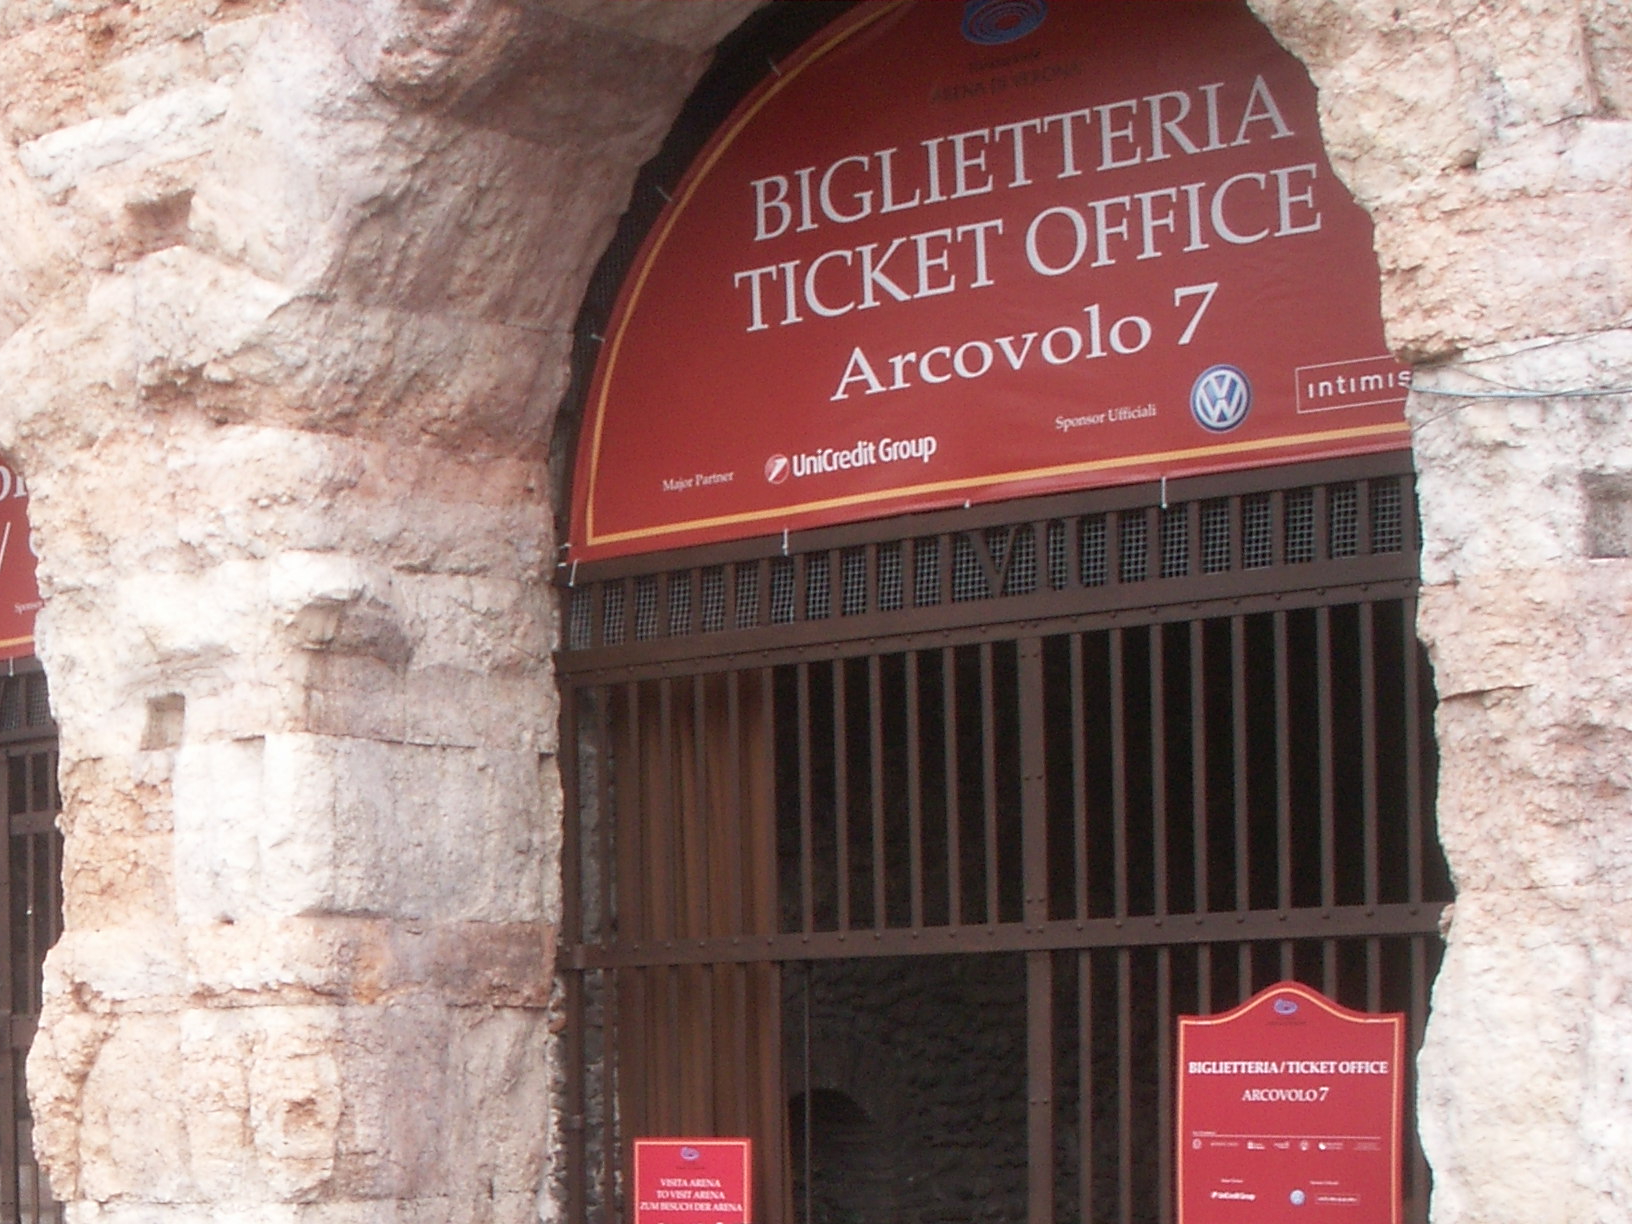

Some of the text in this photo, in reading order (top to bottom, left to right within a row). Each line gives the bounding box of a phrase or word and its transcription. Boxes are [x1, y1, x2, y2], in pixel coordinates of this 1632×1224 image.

[750, 74, 1294, 241] BIGLIETTERIA
[735, 163, 1321, 332] TICKET OFFICE
[830, 283, 1219, 402] Arcovolo 7
[1055, 403, 1157, 432] Sponsor Ufficiali
[792, 435, 937, 477] UniCredit Group
[662, 471, 734, 493] Major Partner
[1188, 1061, 1278, 1074] BIGLIETTERIA
[1286, 1061, 1337, 1074] TICKET
[1338, 1061, 1389, 1074] OFFICE
[1242, 1087, 1329, 1102] ARCOVOLO 7
[688, 1178, 721, 1188] ARENA
[692, 1190, 725, 1199] ARENA
[711, 1202, 743, 1212] ARENA
